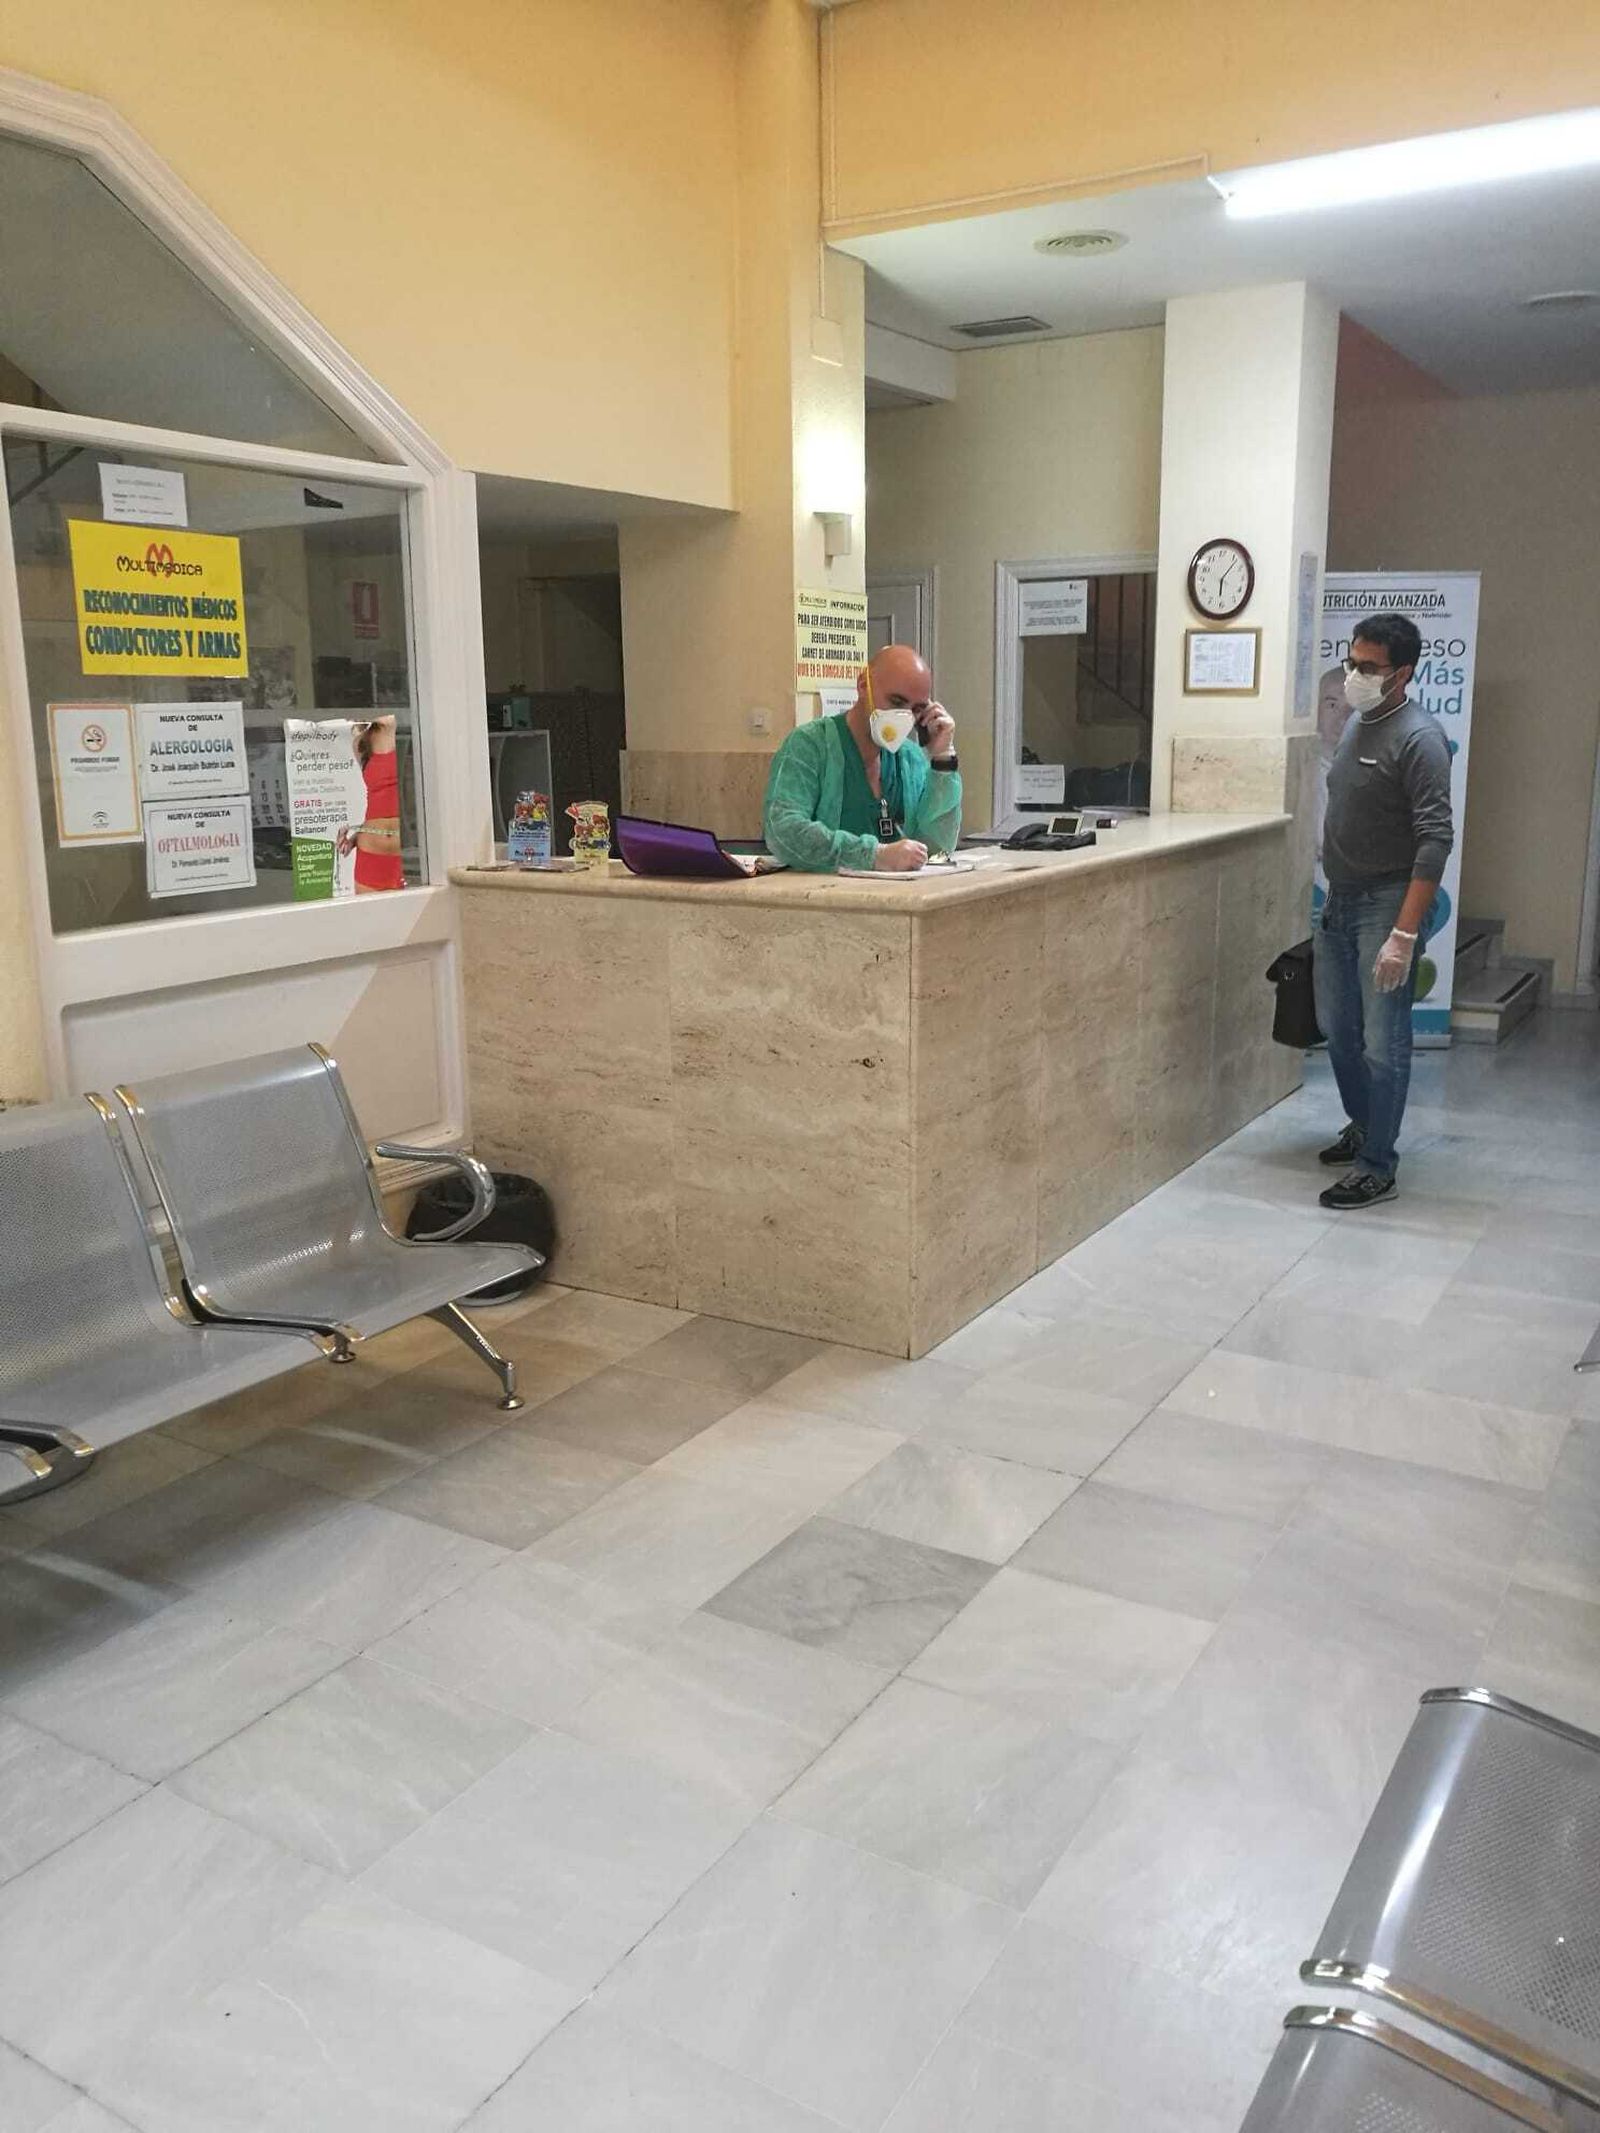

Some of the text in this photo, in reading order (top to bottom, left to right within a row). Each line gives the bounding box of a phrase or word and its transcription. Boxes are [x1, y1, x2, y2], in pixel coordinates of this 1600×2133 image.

[83, 589, 238, 621] RECONOCIMIENTOS MÉDICOS
[1379, 594, 1446, 608] AVANZADA
[86, 625, 241, 659] CONDUCTORES Y ARMAS
[1419, 638, 1466, 657] eso
[1418, 689, 1463, 714] lud
[186, 714, 224, 722] CONSULTA
[297, 761, 326, 775] perder
[293, 799, 321, 809] GRATIS
[167, 810, 230, 821] NUEVA CONSULTA
[295, 813, 348, 826] presoterapia
[296, 842, 332, 854] NOVEDAD
